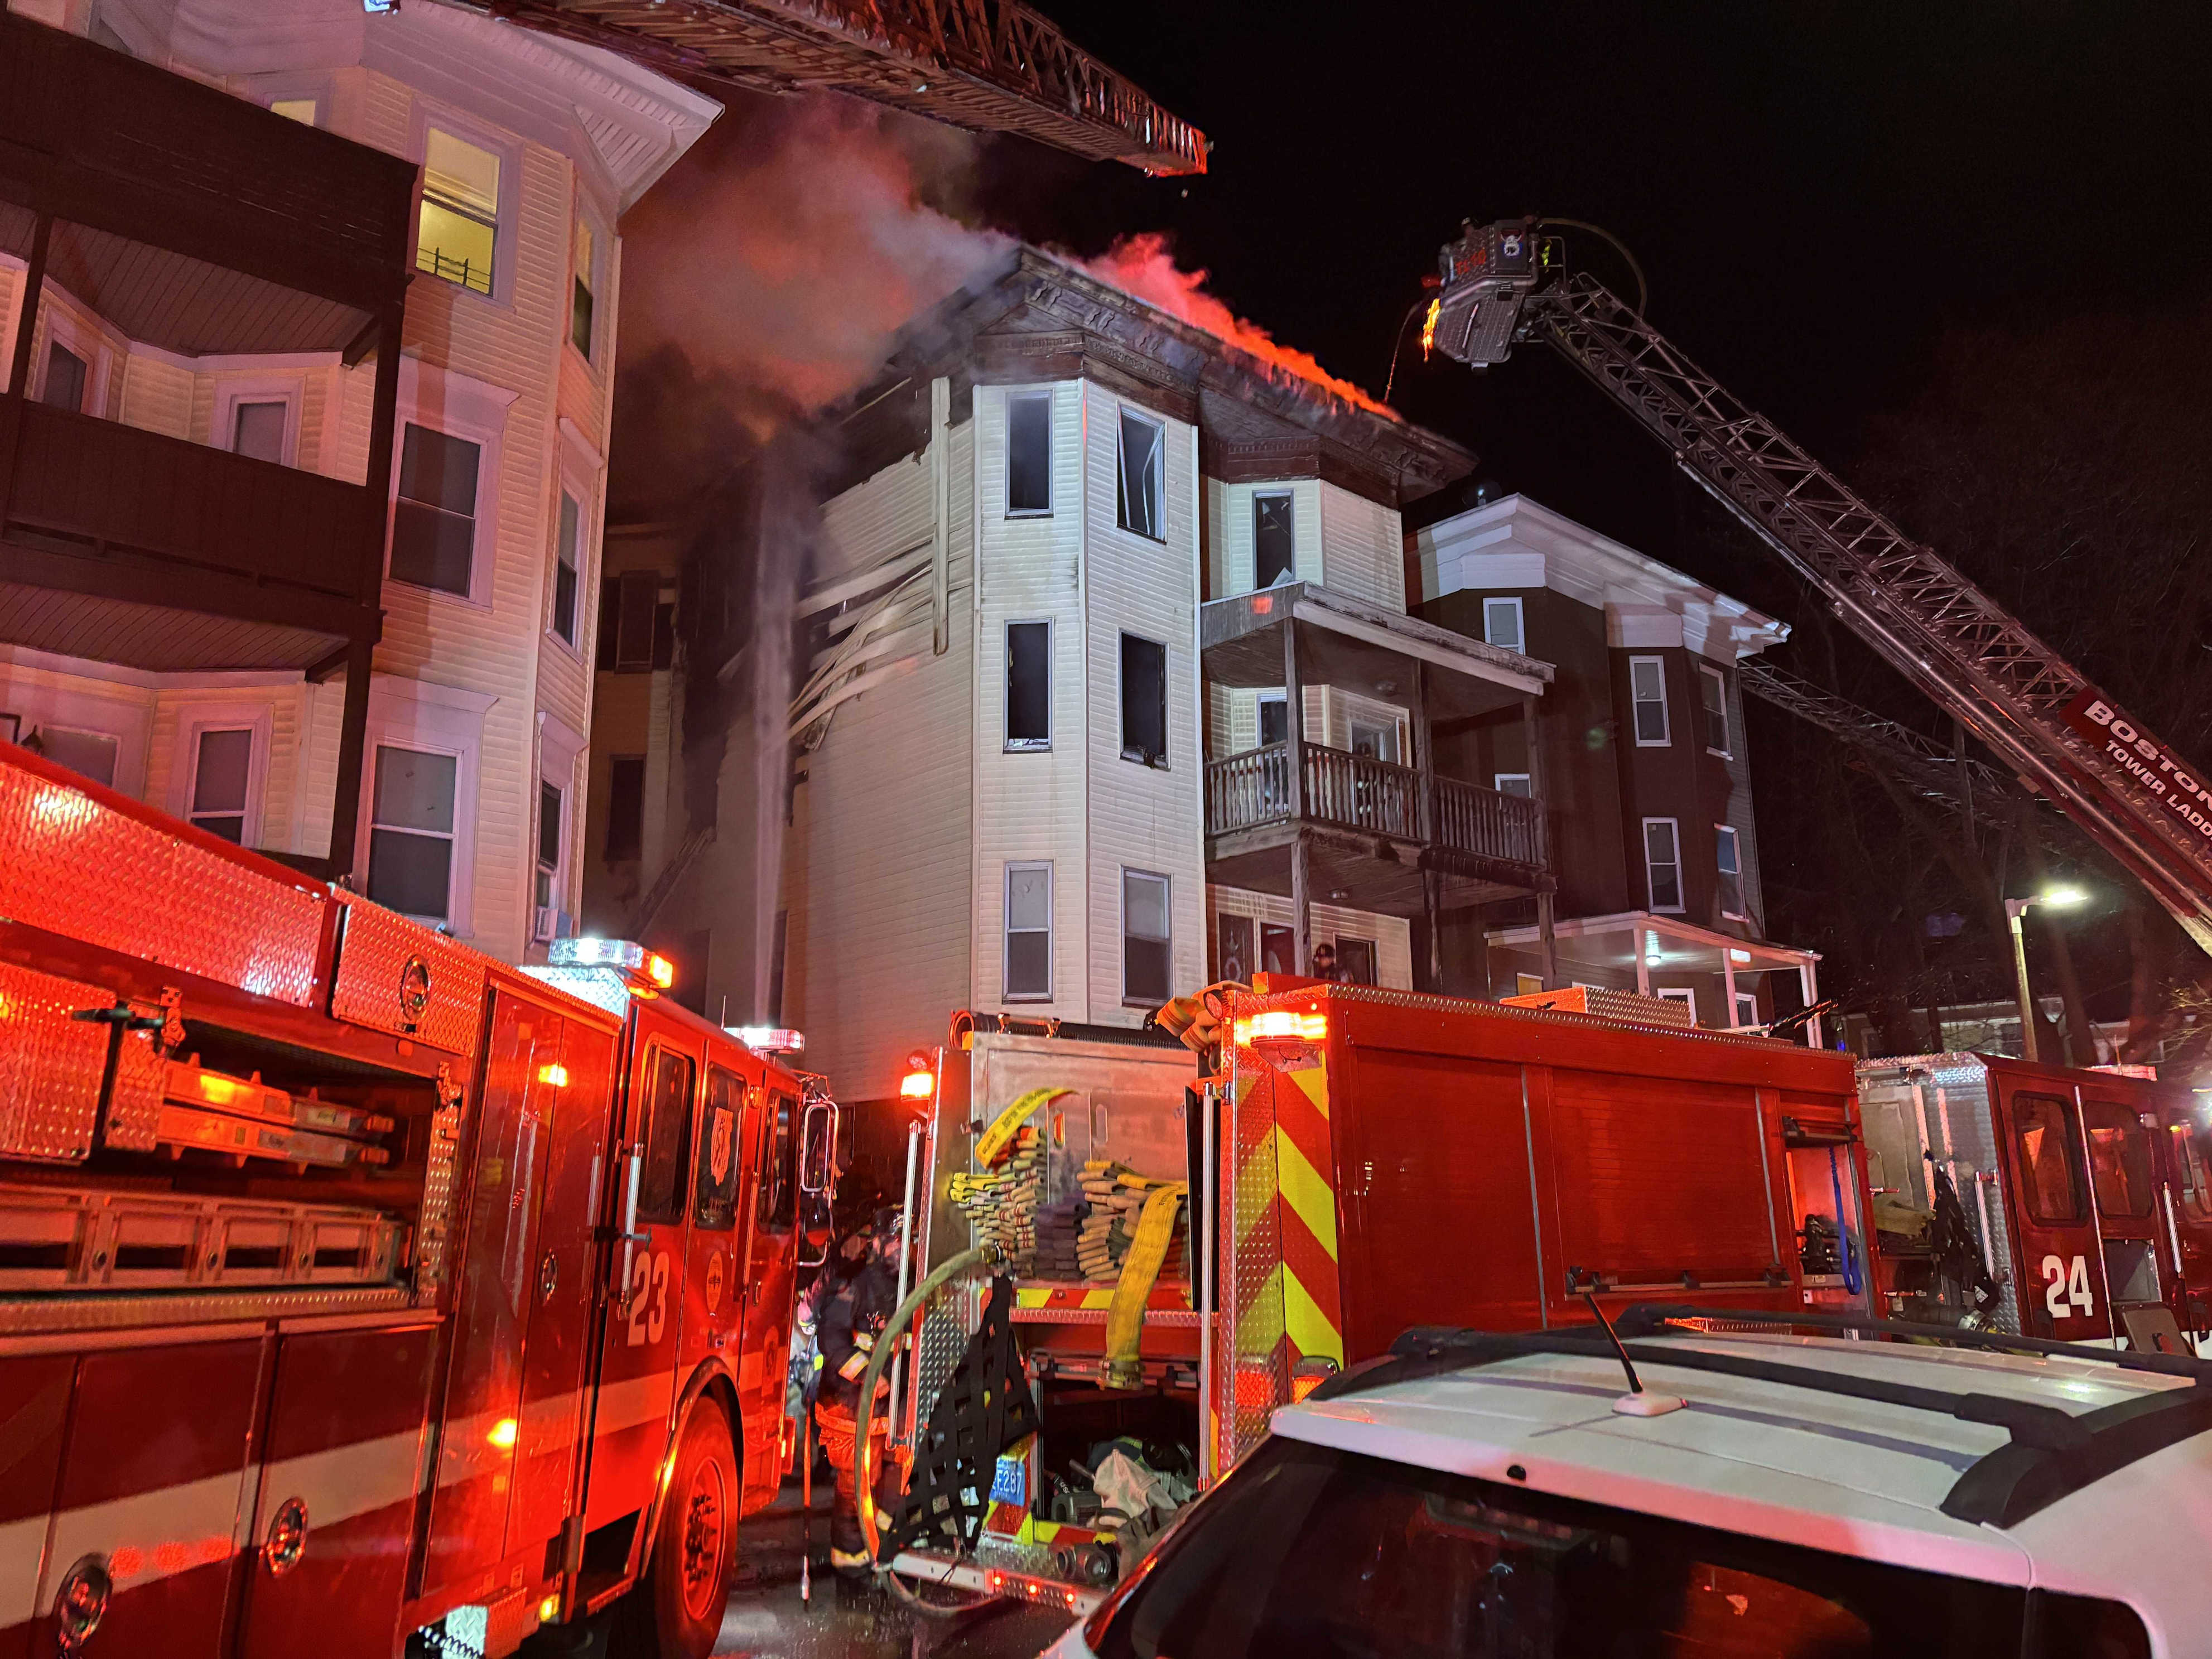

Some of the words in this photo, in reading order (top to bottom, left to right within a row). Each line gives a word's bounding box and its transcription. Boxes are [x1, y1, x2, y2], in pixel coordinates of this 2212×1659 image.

[2105, 740, 2166, 795] TOWER
[2167, 794, 2212, 841] LADD
[627, 1251, 669, 1347] 23
[2042, 1255, 2093, 1319] 24
